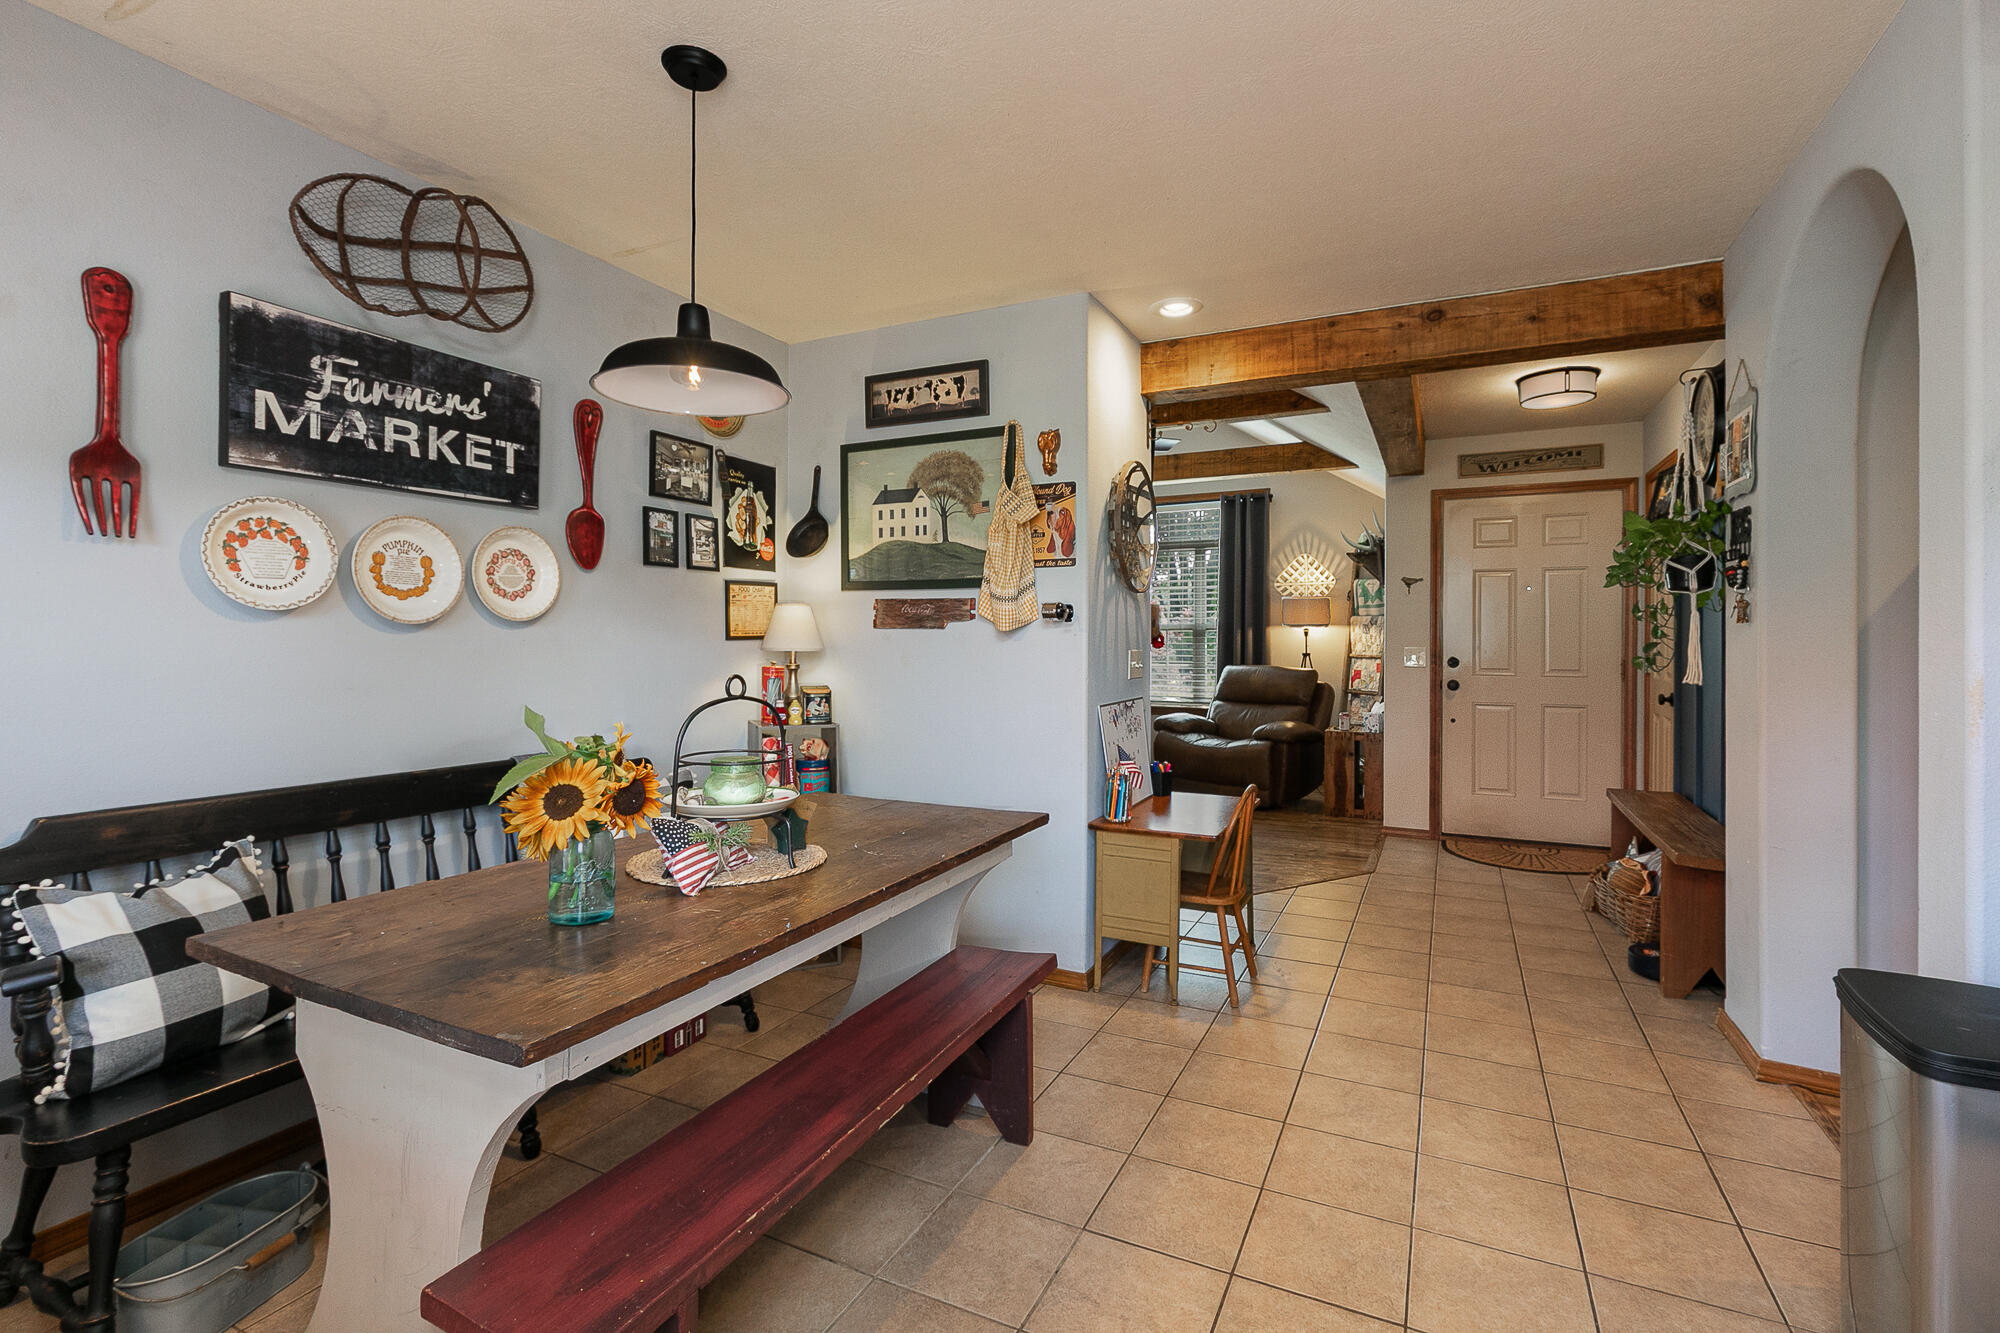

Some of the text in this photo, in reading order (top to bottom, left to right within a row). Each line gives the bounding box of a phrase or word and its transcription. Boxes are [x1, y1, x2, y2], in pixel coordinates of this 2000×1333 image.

[305, 354, 492, 420] Farmers'
[254, 388, 525, 475] MARKET
[1055, 483, 1072, 497] Dog
[382, 540, 424, 556] PUMPKIN
